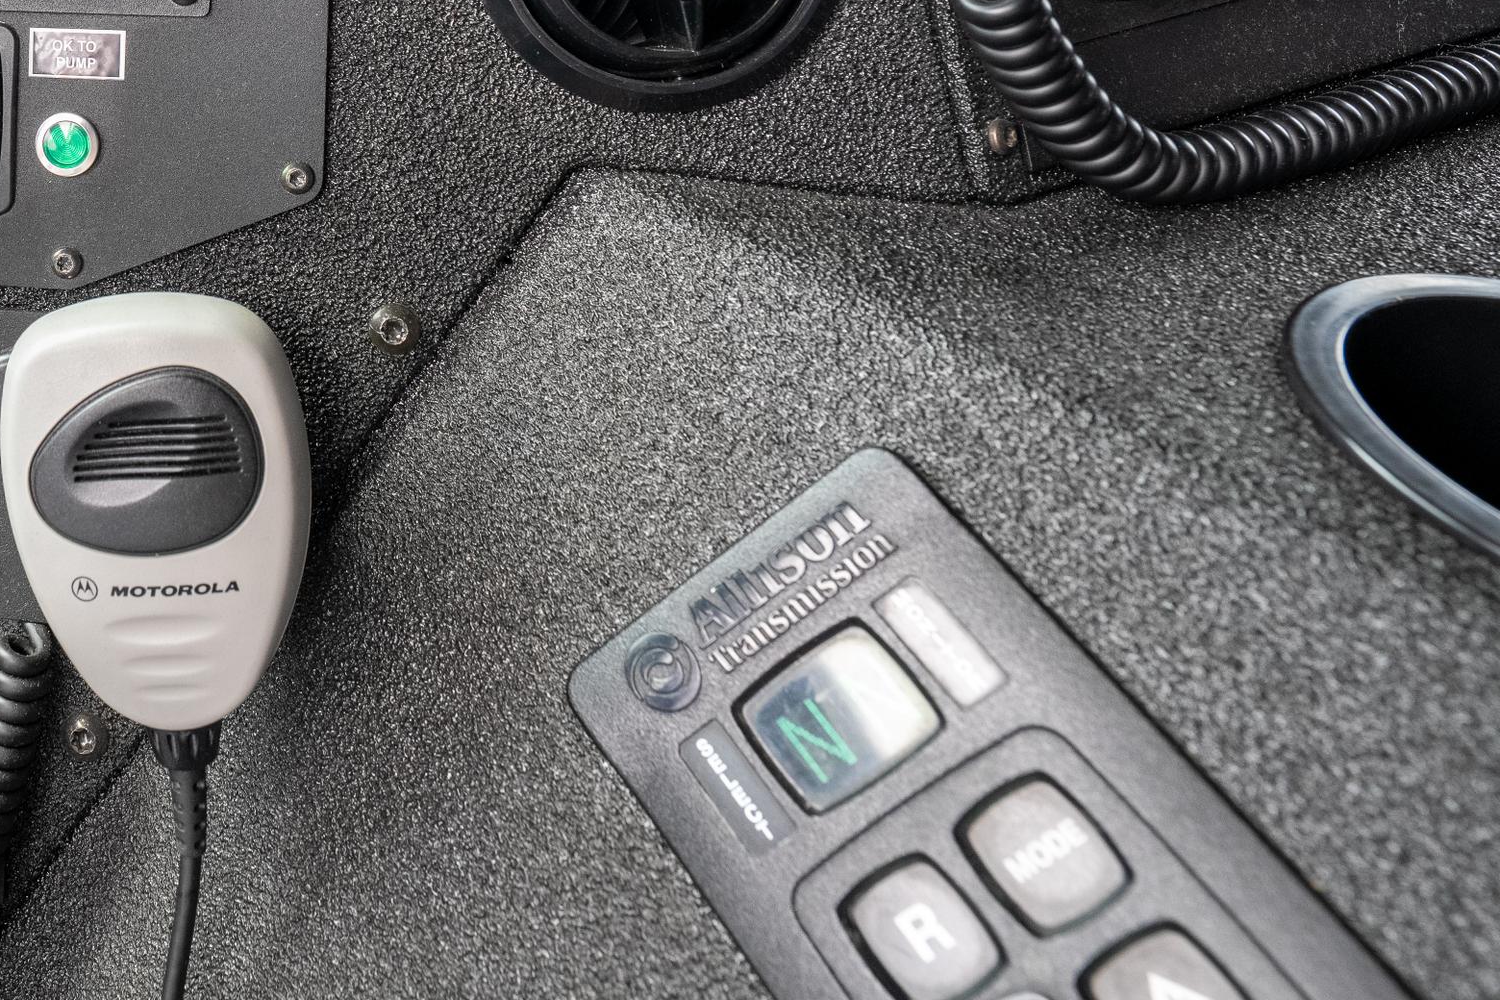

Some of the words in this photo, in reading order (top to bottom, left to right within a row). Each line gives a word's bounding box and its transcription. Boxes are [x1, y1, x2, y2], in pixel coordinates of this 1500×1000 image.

[51, 40, 73, 53] OK
[77, 41, 97, 53] TO
[56, 57, 97, 69] PUMP
[110, 581, 240, 598] MOTOROLA
[689, 500, 872, 650] Allison
[708, 533, 899, 674] Transmission
[776, 699, 858, 784] N
[696, 738, 774, 840] SELECT
[1003, 817, 1088, 884] MODE
[894, 901, 956, 965] R
